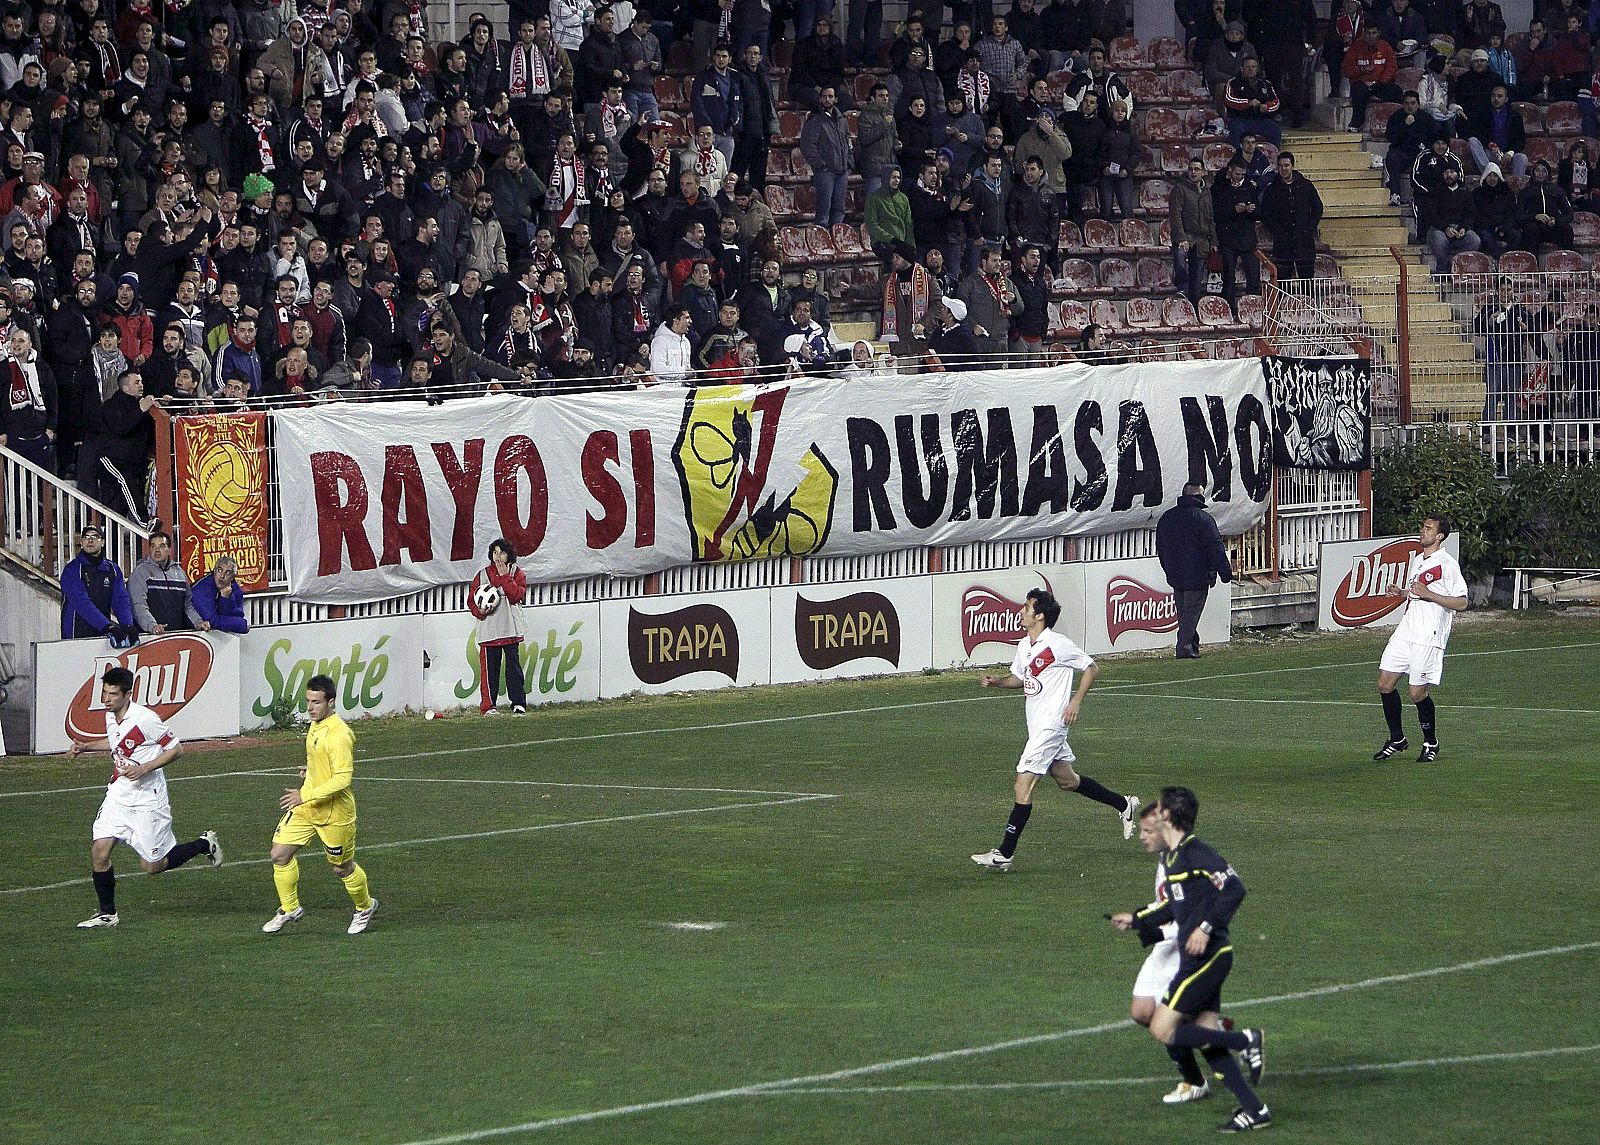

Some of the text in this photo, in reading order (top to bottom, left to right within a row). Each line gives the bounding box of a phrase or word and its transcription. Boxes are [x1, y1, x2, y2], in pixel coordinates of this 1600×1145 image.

[310, 429, 655, 577] RAYO SI
[846, 394, 1272, 533] RUMASA NO
[642, 622, 727, 664] TRAPA
[808, 609, 889, 650] TRAPA
[1109, 589, 1178, 625] Tranchett
[251, 634, 392, 718] Santé
[454, 620, 585, 700] Snté
